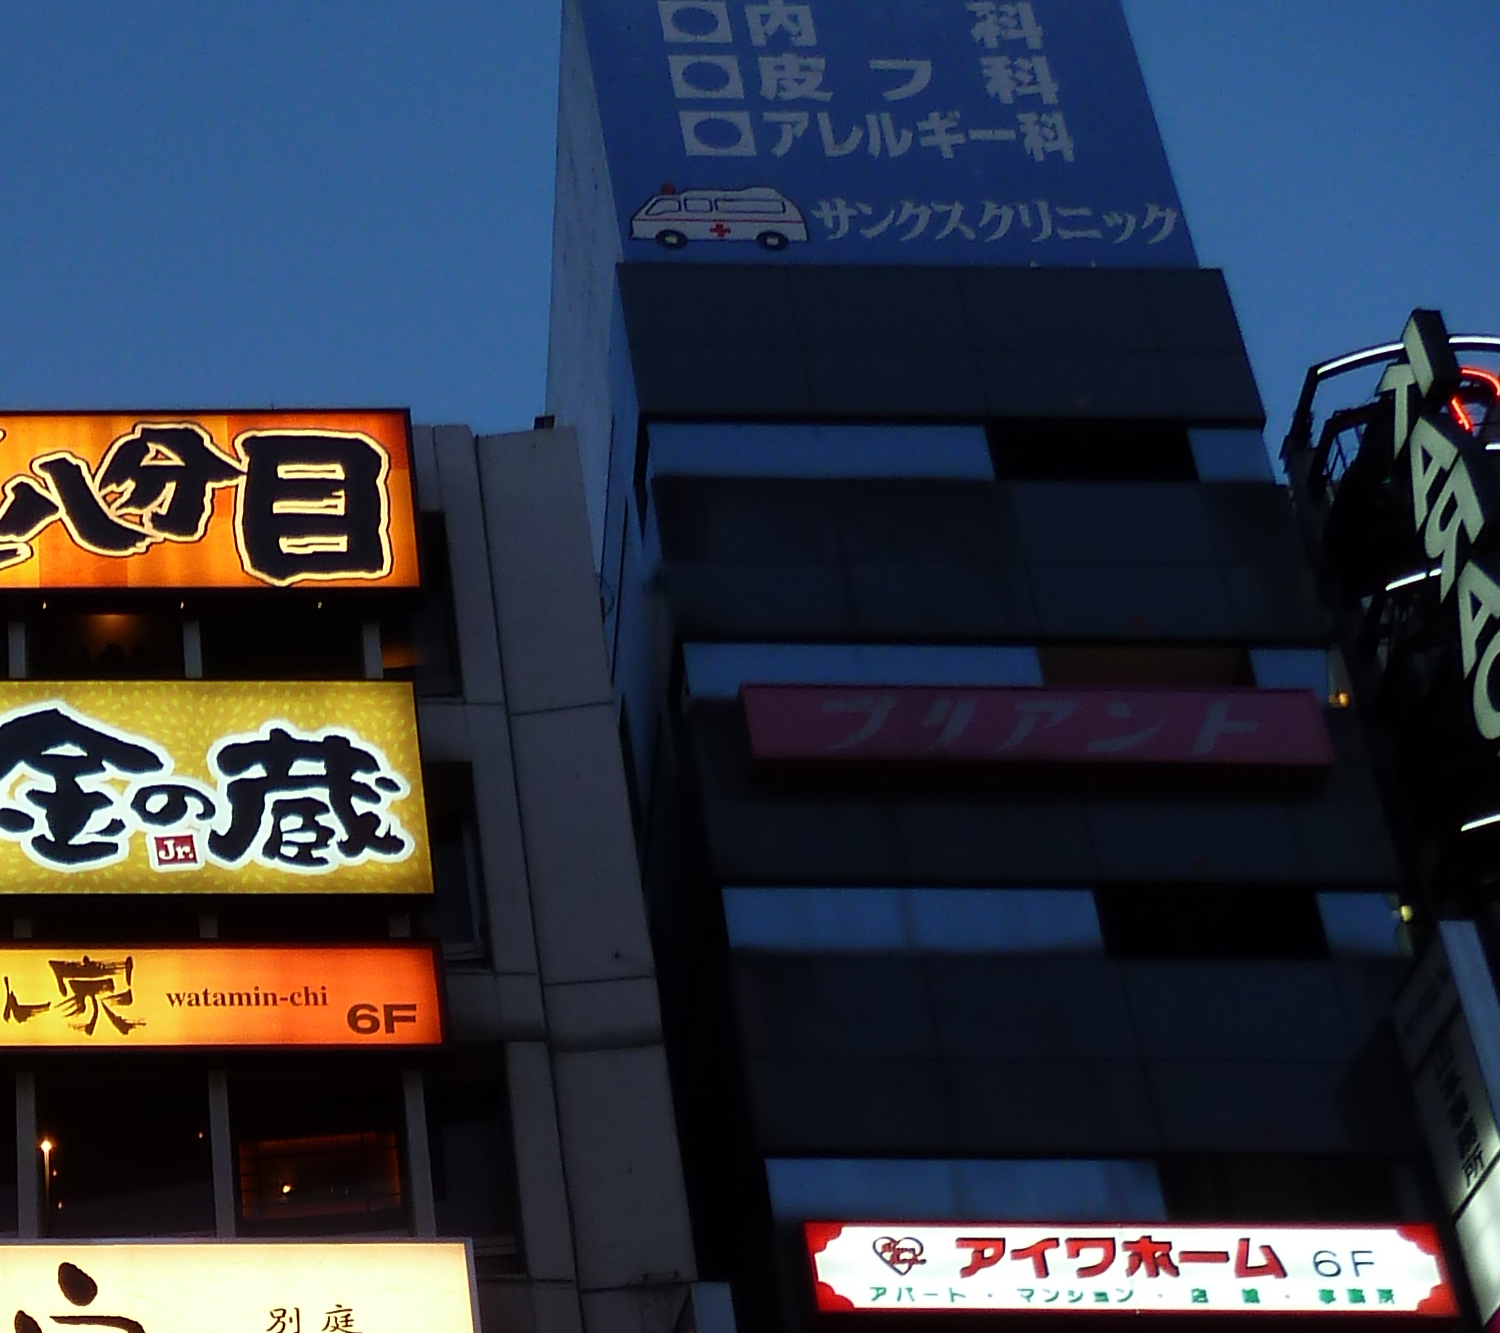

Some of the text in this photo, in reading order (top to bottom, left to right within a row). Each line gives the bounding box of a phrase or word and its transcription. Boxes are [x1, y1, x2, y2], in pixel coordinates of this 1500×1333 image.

[758, 55, 1061, 106] 皮フ科
[762, 110, 1077, 163] アレルギー科
[810, 198, 1178, 245] サンクスクリニック
[156, 834, 198, 865] Jr.
[164, 981, 330, 1013] watamin-chi
[345, 1002, 419, 1036] 6F
[955, 1236, 1289, 1280] アイワホーム
[1312, 1249, 1377, 1278] 6F
